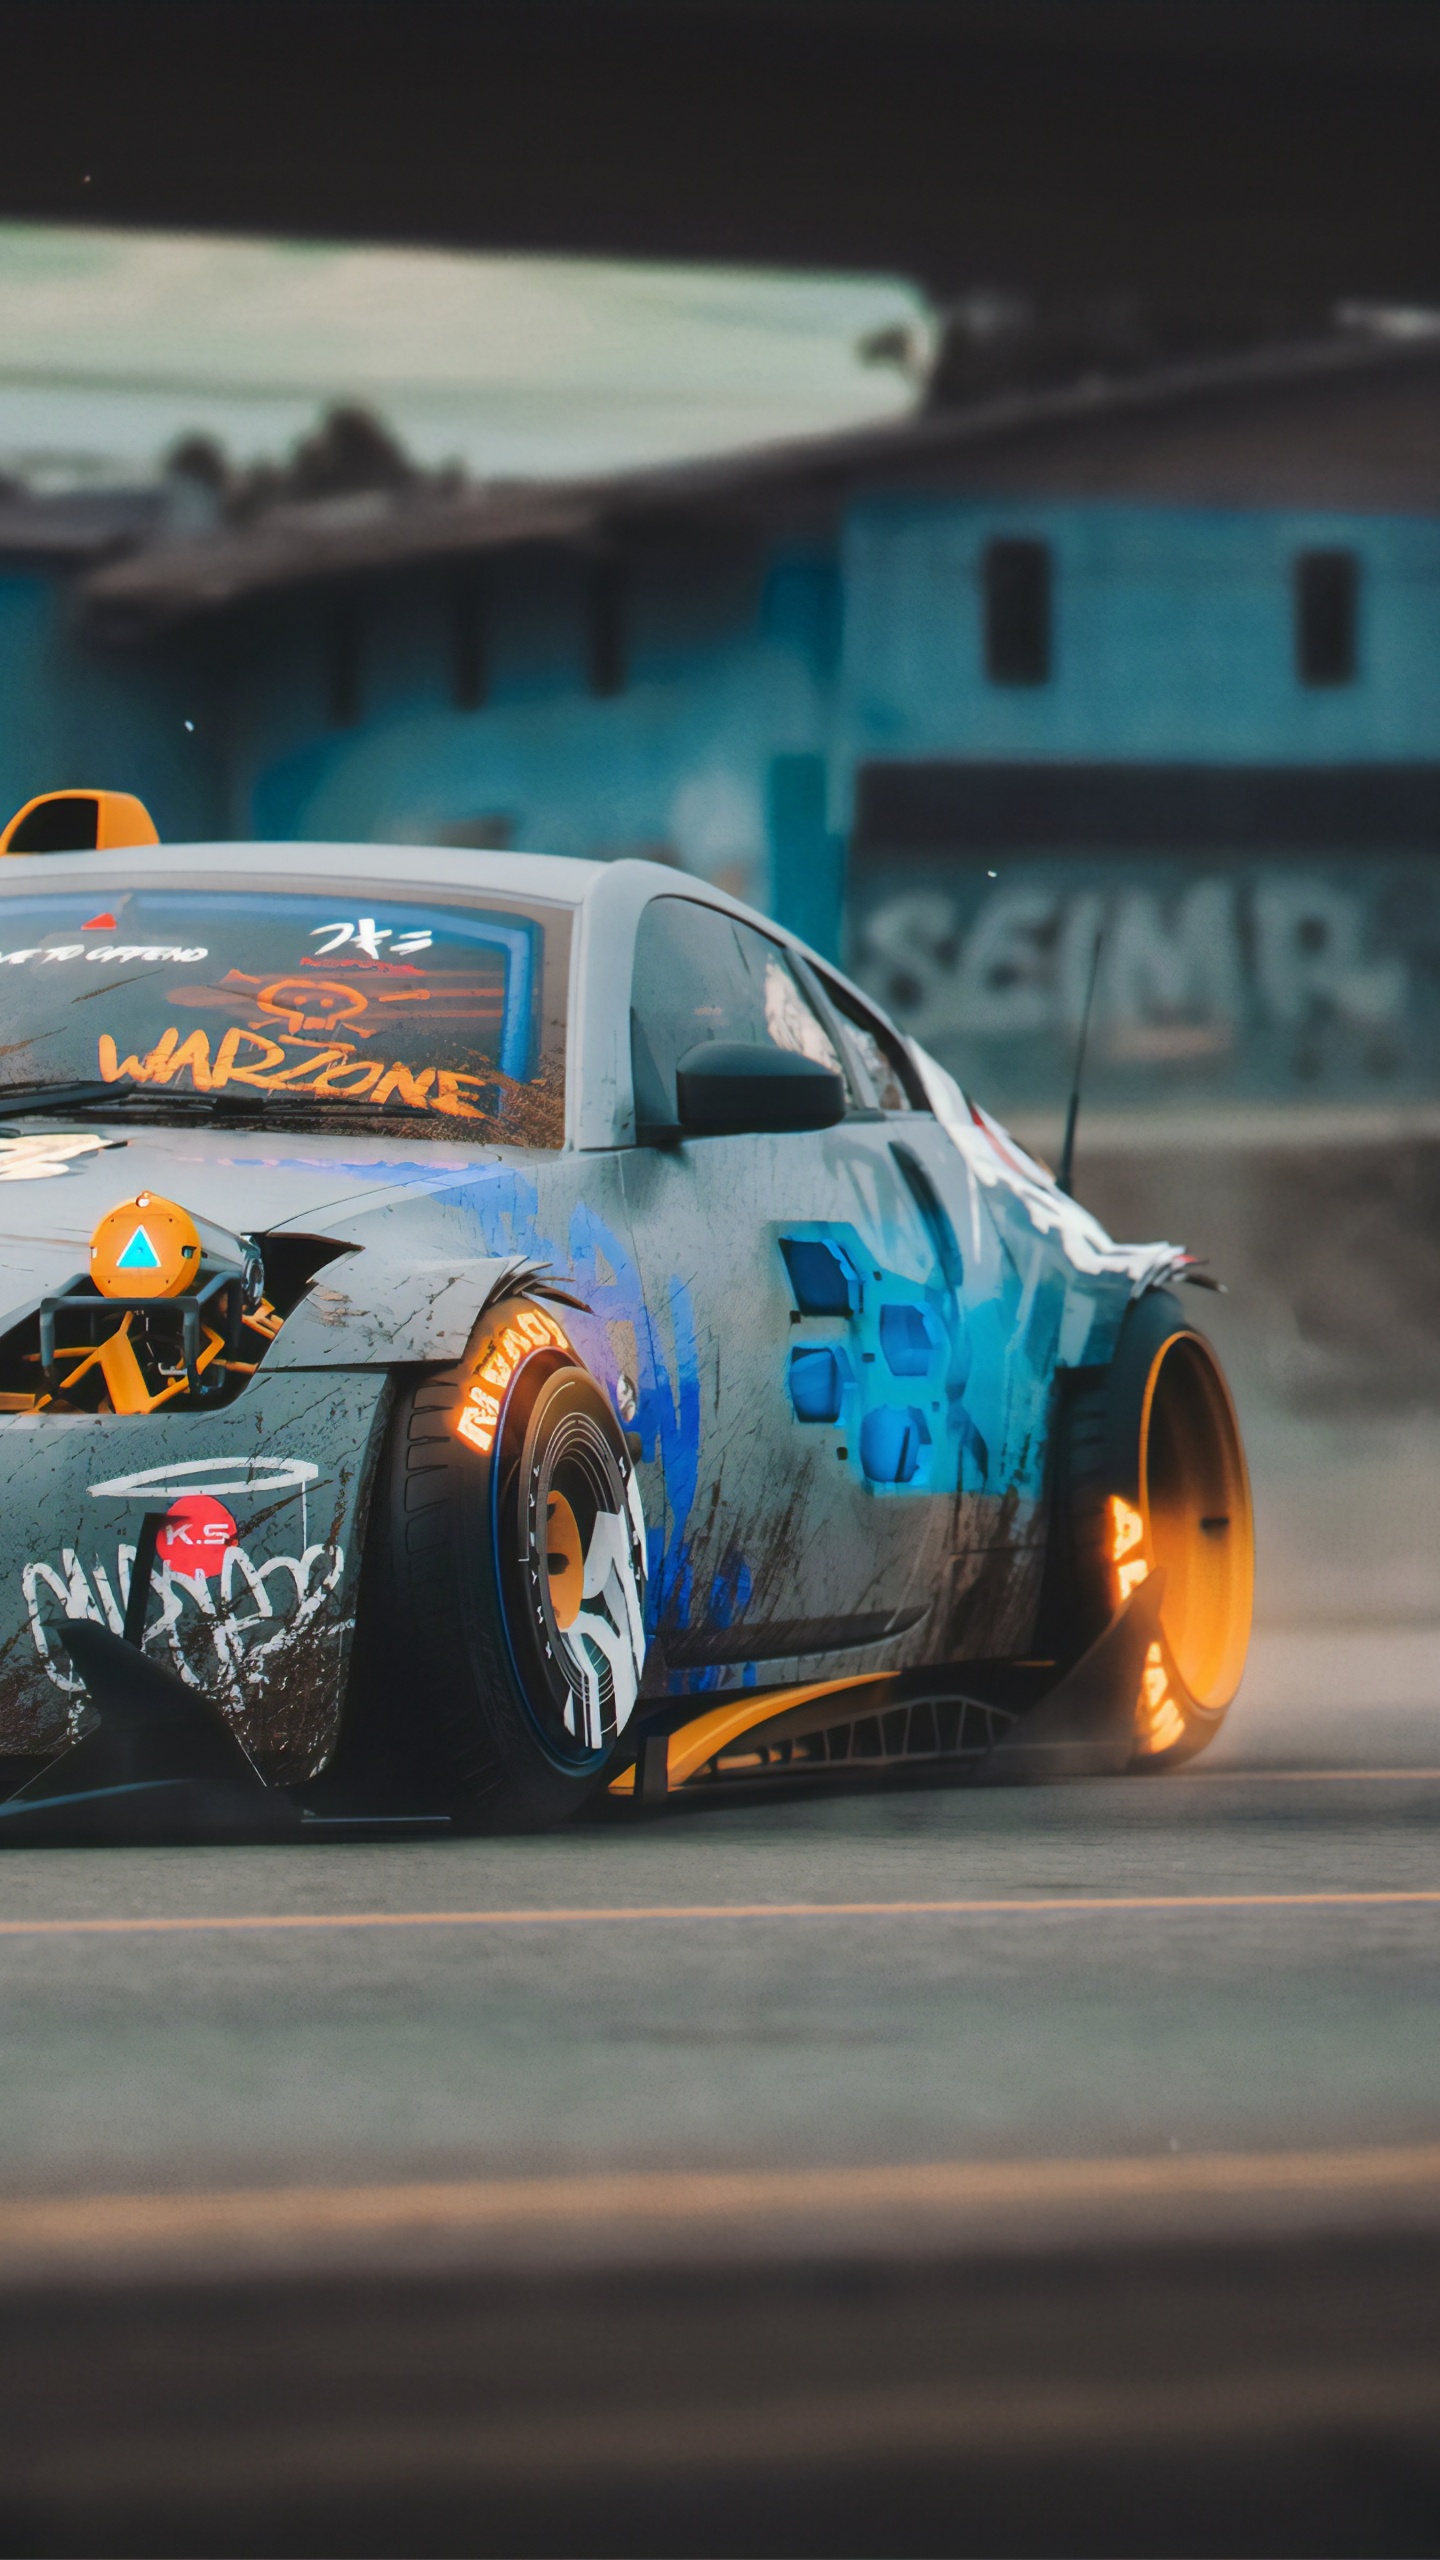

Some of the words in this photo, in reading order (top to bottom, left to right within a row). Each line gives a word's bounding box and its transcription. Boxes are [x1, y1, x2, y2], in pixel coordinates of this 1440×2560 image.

[41, 944, 85, 965] TO
[85, 945, 209, 963] OFFEND
[100, 1027, 486, 1119] WARZONE
